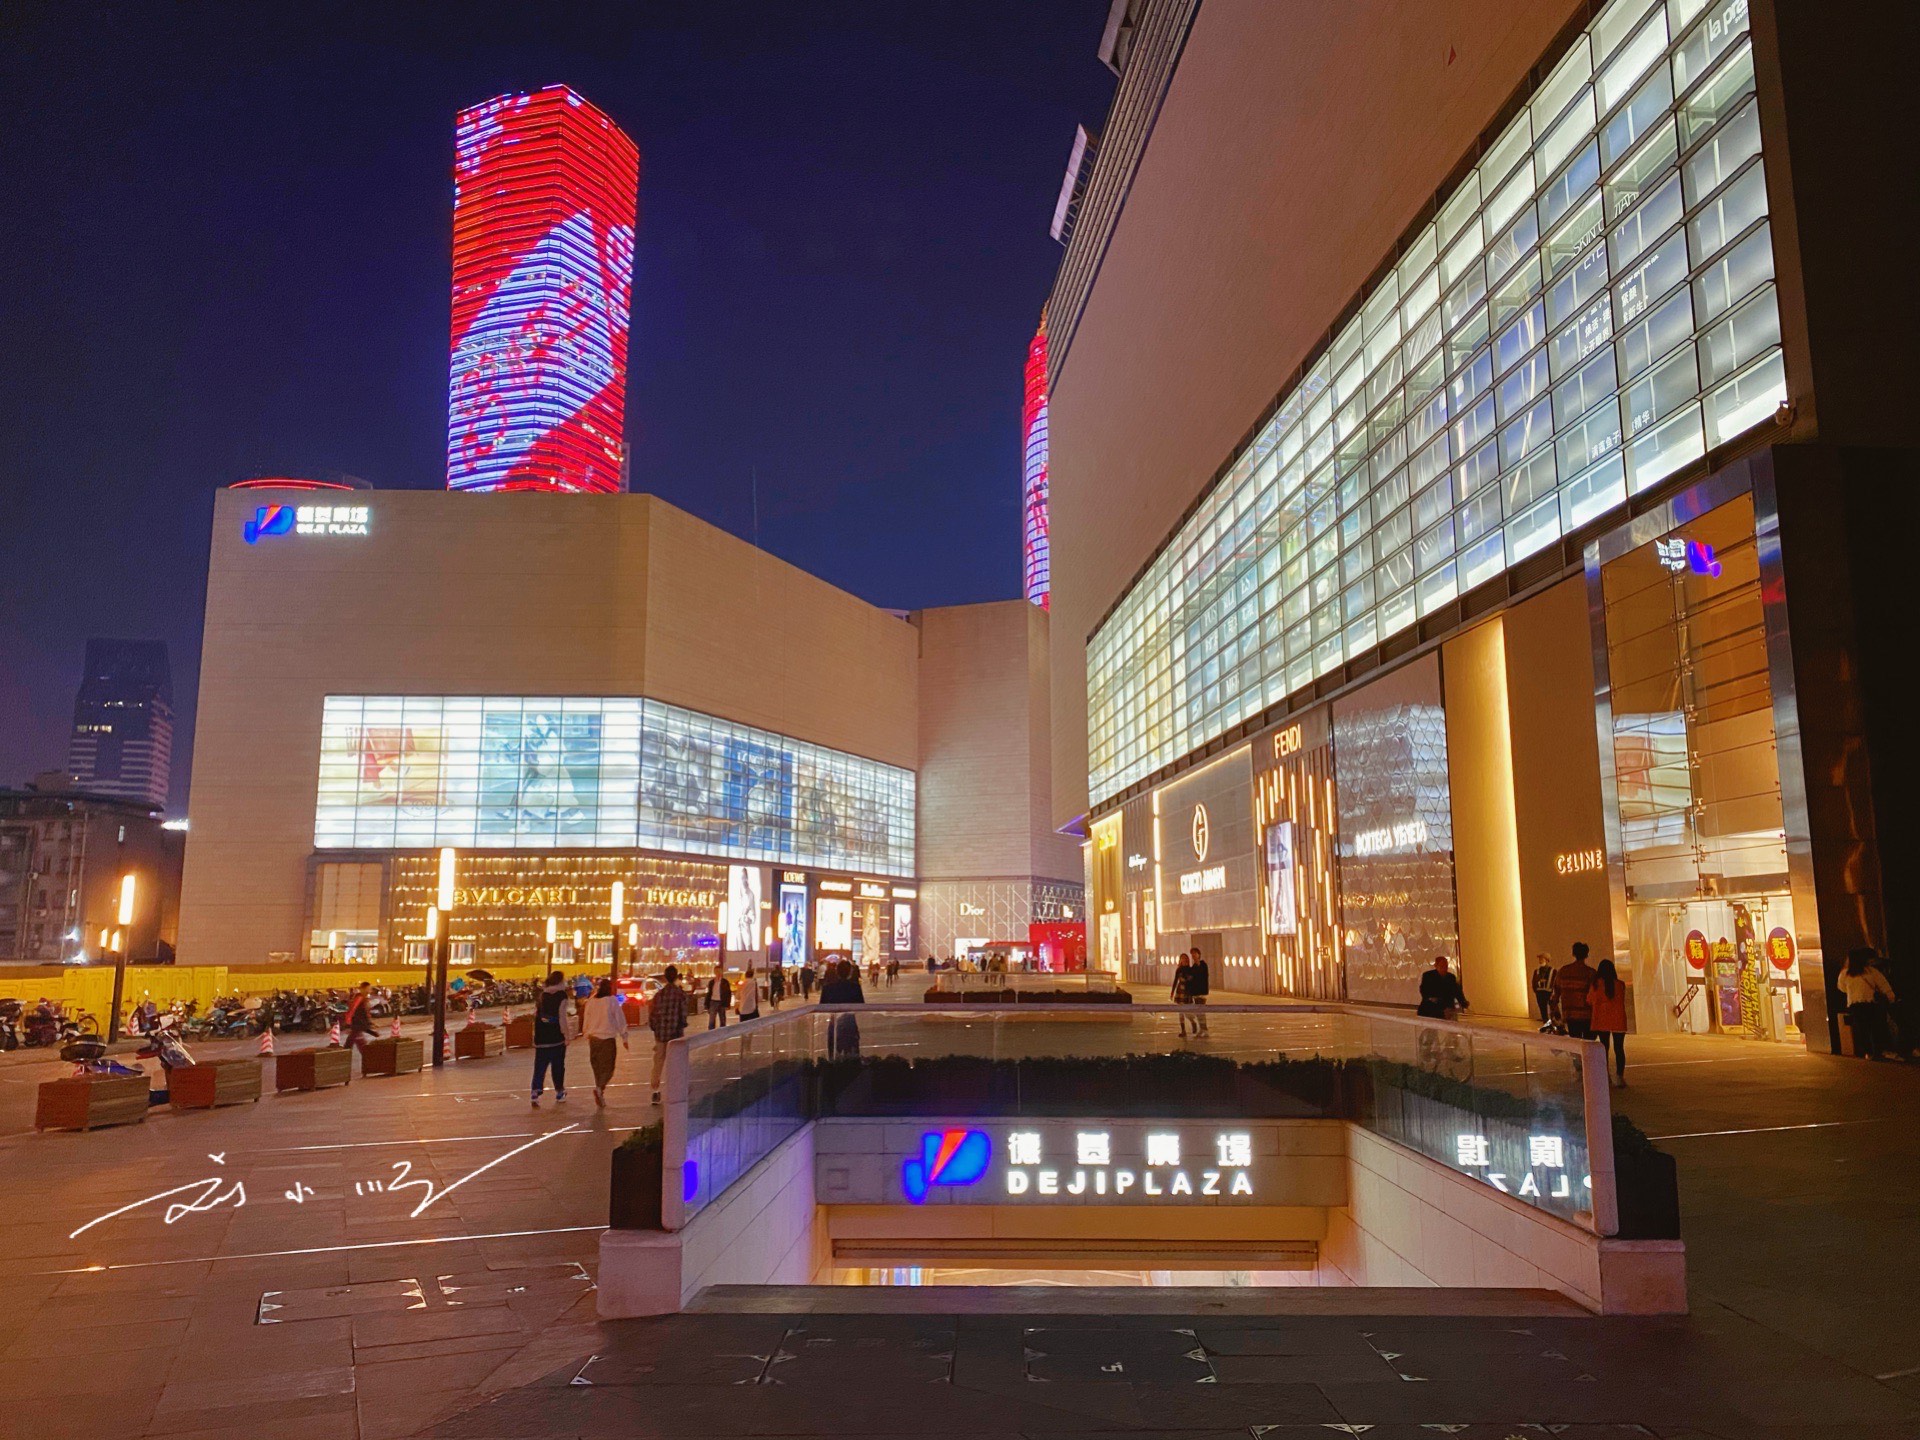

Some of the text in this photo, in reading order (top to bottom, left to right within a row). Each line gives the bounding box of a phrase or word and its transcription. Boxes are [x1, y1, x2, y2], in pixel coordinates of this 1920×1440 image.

[329, 523, 368, 535] PLAZA
[1274, 723, 1302, 759] FENDI
[1356, 819, 1427, 856] BOTTEGA VENETA
[1557, 849, 1603, 874] CELINE
[453, 889, 577, 905] BVLGARI
[960, 902, 985, 916] Dior
[1745, 938, 1760, 1012] HAPPINESS
